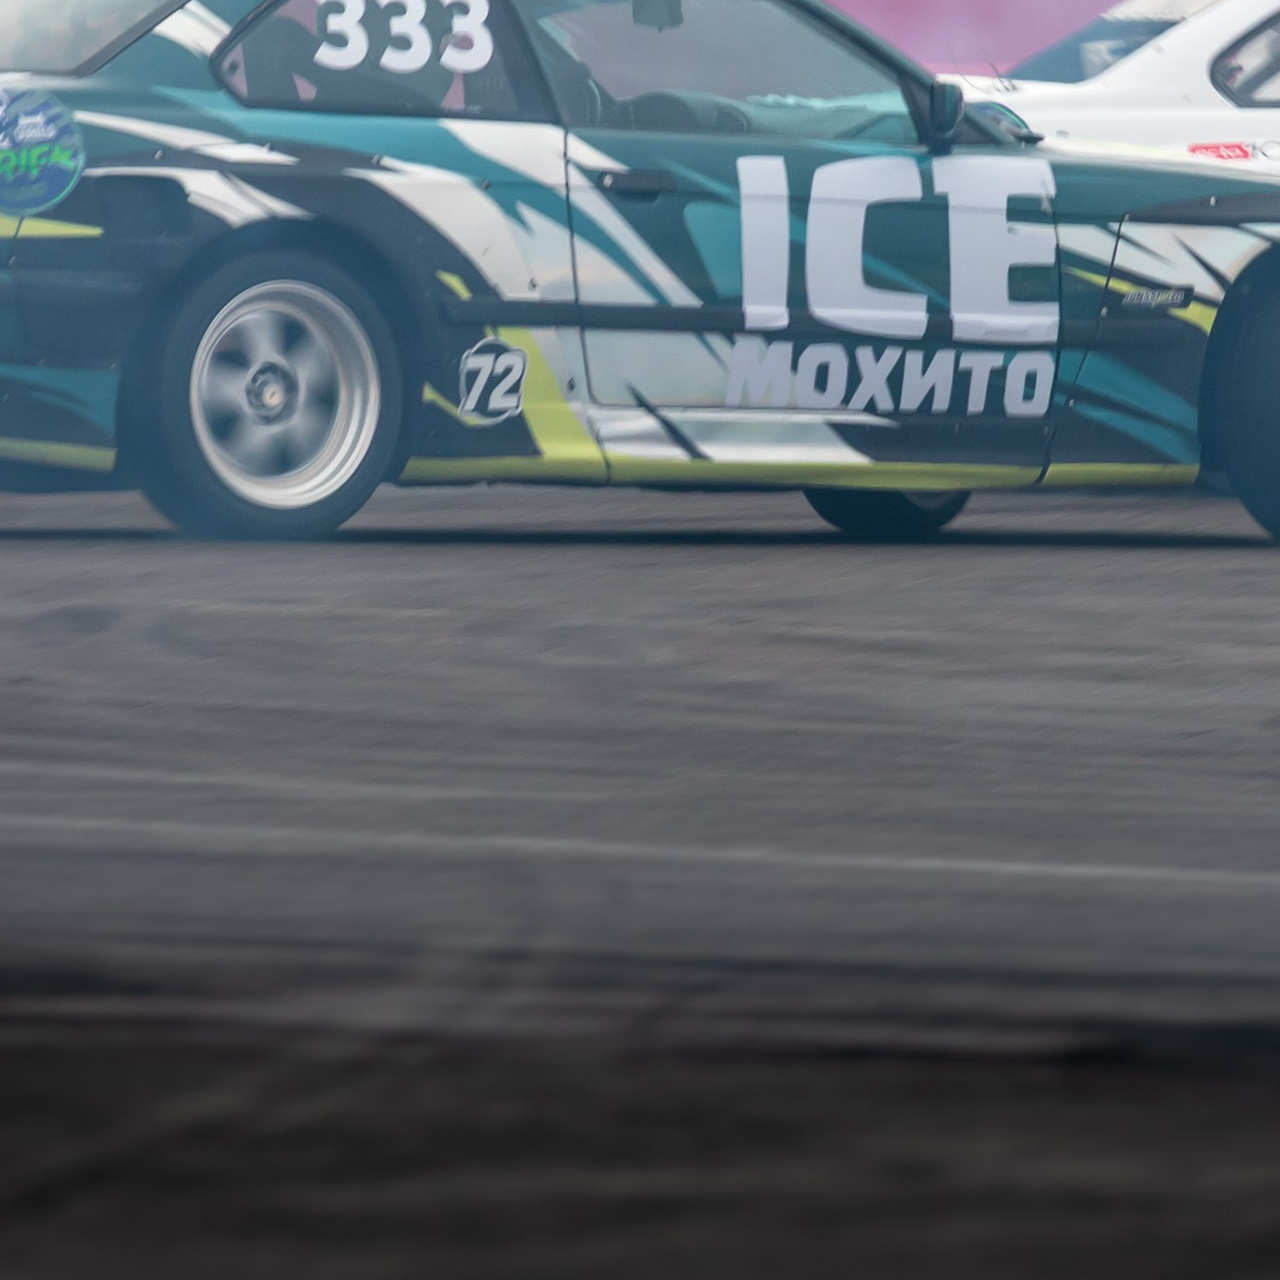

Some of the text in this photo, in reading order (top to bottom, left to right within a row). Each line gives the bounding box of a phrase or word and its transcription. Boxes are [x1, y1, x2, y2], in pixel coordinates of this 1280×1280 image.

[736, 155, 1059, 345] ICE
[463, 352, 524, 414] 72
[724, 339, 1057, 418] МОХИТО
